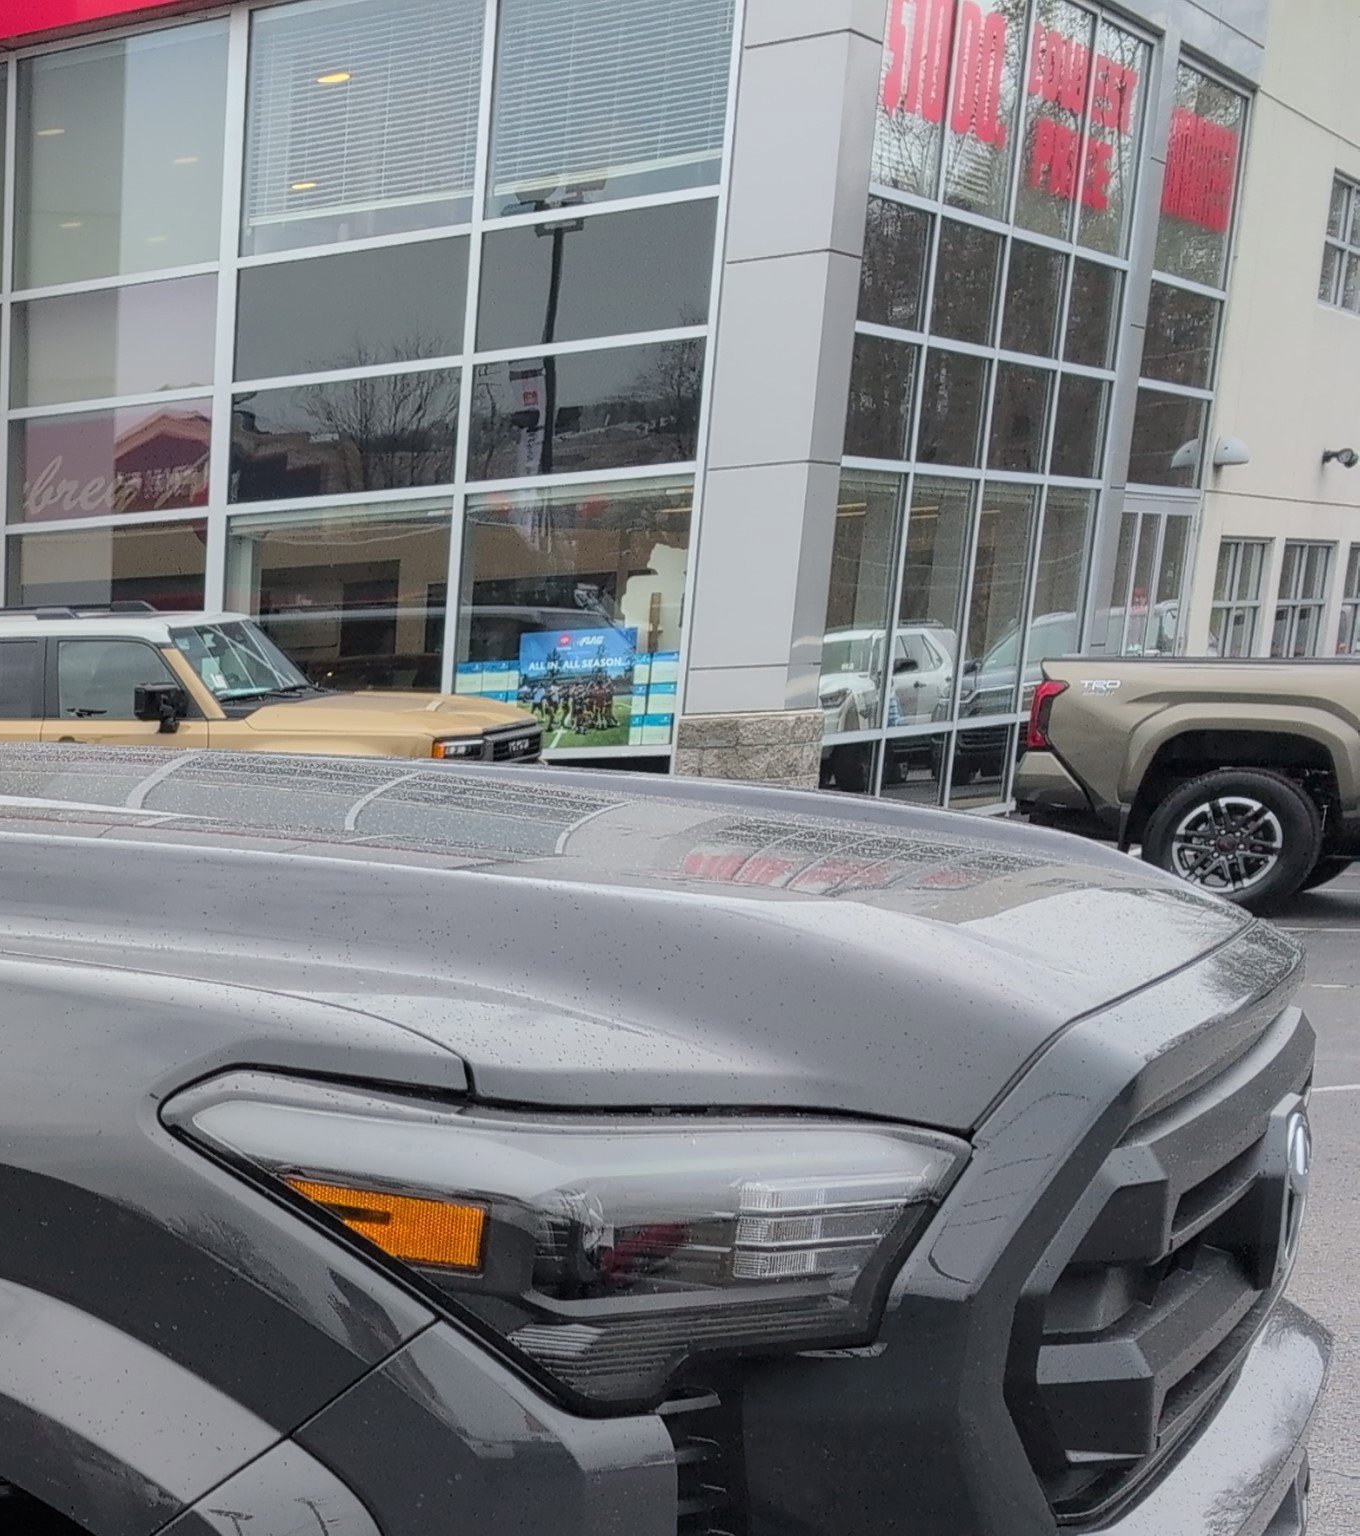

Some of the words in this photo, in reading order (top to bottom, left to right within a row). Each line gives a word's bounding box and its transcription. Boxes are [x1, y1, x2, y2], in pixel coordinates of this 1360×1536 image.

[529, 661, 545, 671] ALL
[562, 659, 580, 670] ALL
[1080, 679, 1121, 691] TRD
